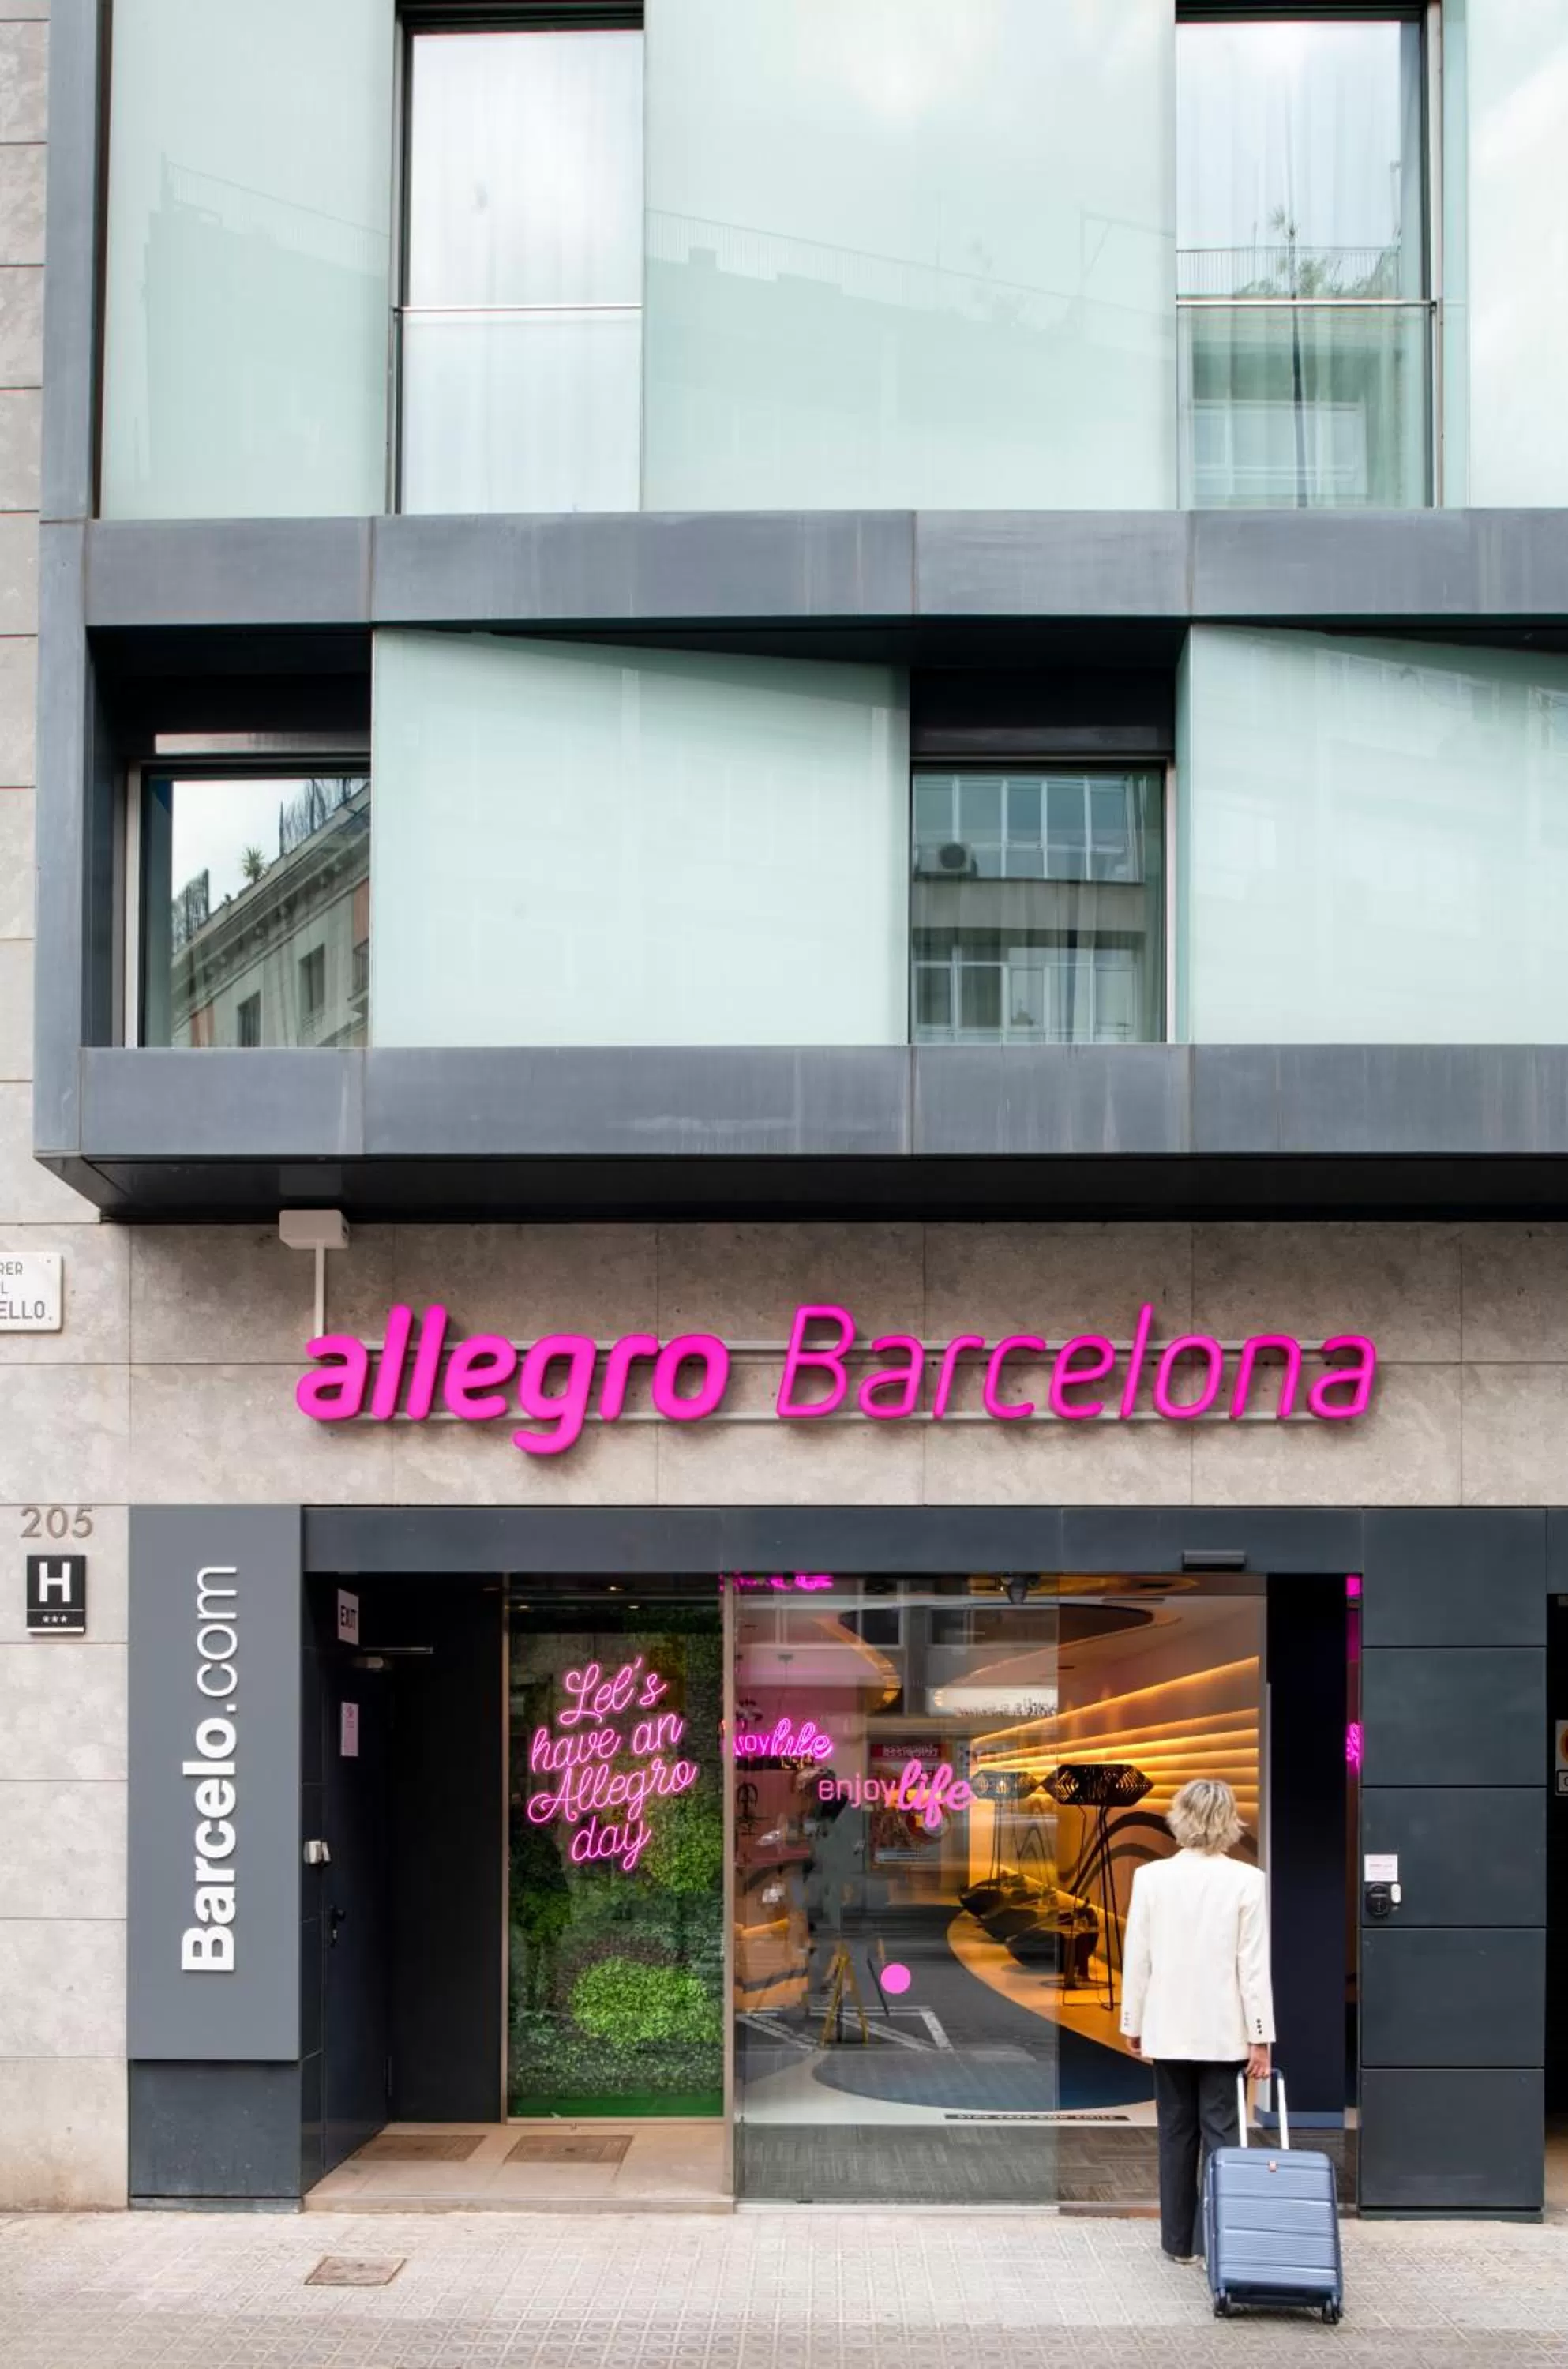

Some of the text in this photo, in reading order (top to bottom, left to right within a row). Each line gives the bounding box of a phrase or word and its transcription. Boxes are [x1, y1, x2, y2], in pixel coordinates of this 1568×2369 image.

[296, 1303, 1377, 1454] allegro Barcelona
[19, 1506, 94, 1539] 205
[38, 1561, 72, 1603] H
[559, 1657, 668, 1725] Let's
[181, 1566, 238, 1973] Barcelo.com
[530, 1713, 684, 1773] have an
[527, 1757, 698, 1823] Allegro
[571, 1815, 652, 1872] day
